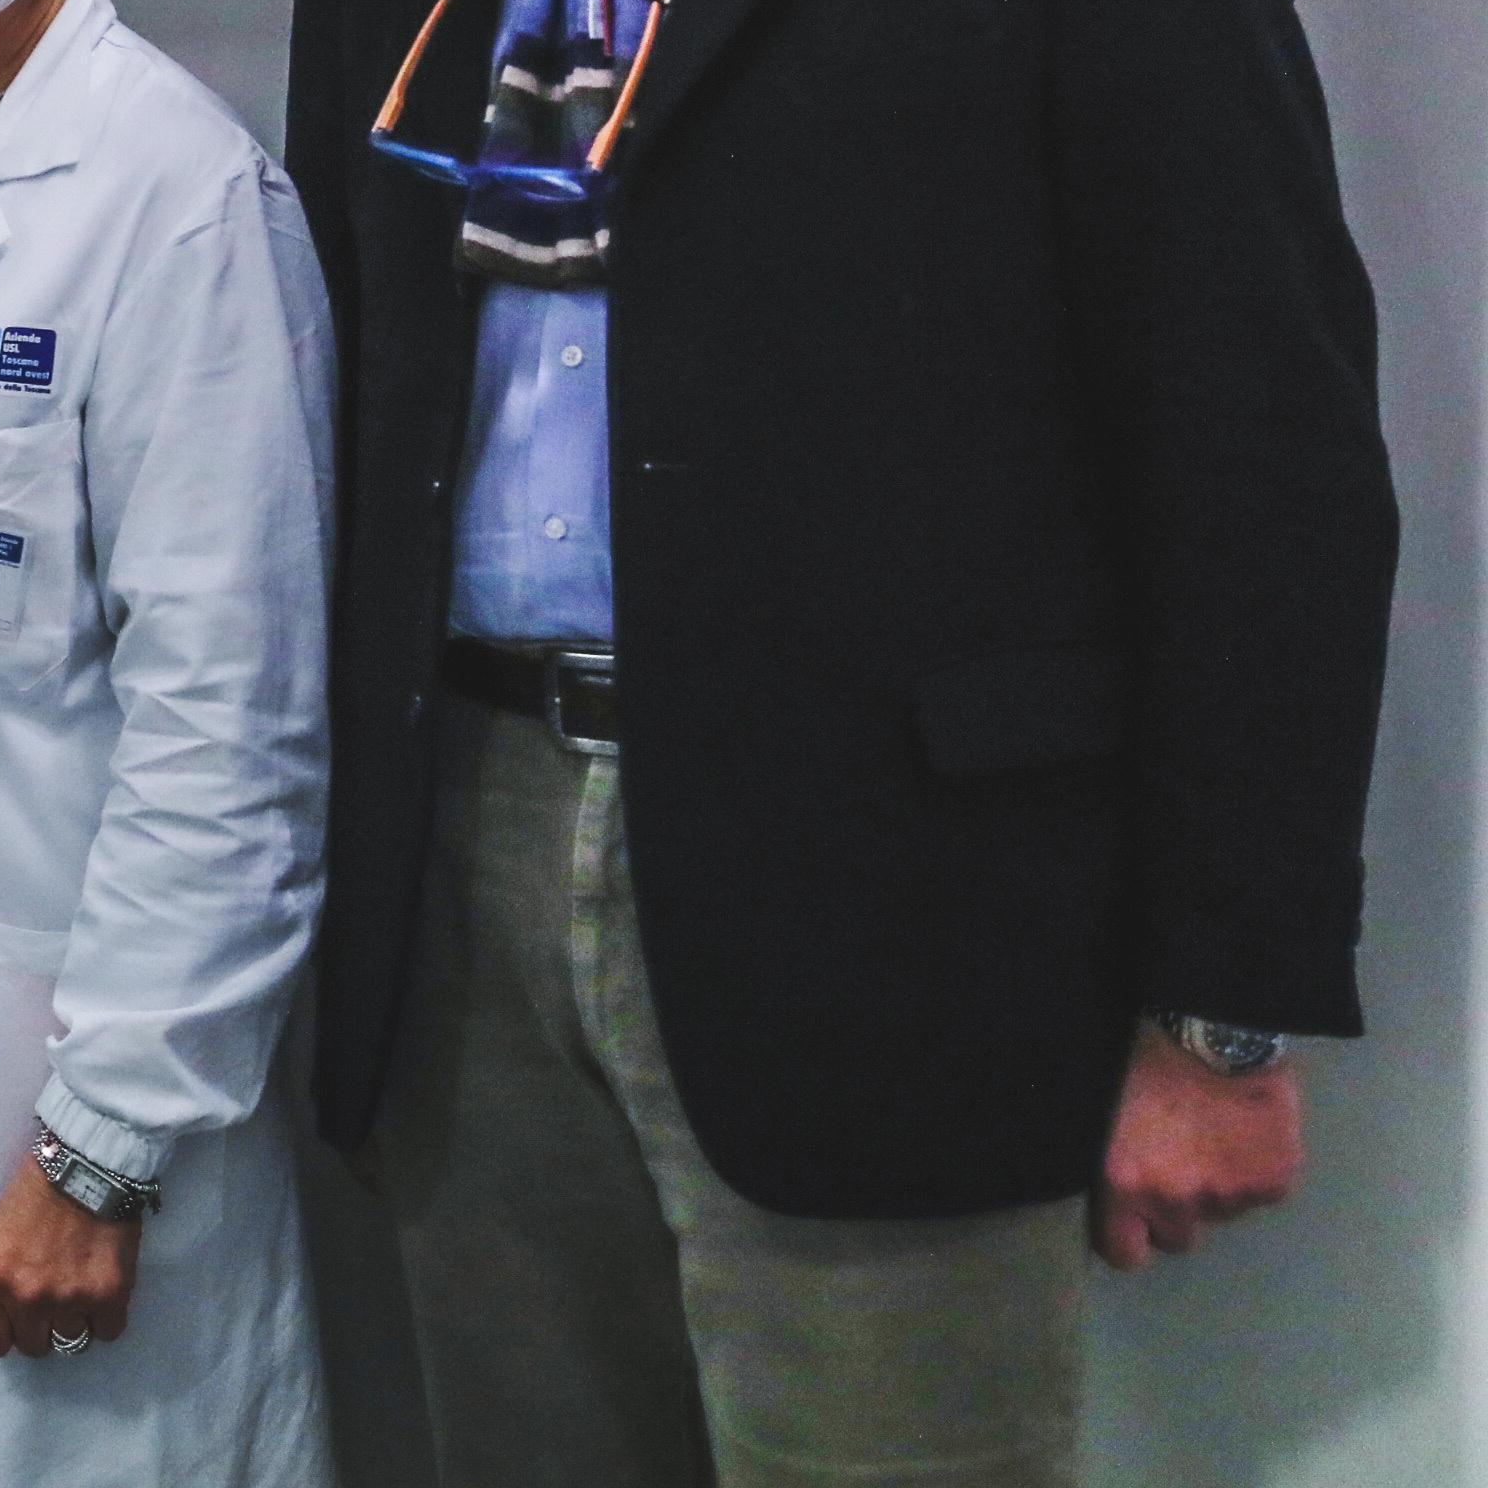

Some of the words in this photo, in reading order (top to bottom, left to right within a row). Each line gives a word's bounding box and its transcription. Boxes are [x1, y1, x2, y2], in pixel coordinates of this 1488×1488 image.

[4, 332, 41, 344] Azienda
[3, 343, 20, 353] USL
[2, 354, 39, 366] Toscana
[0, 368, 22, 377] nord
[25, 371, 50, 380] ovest
